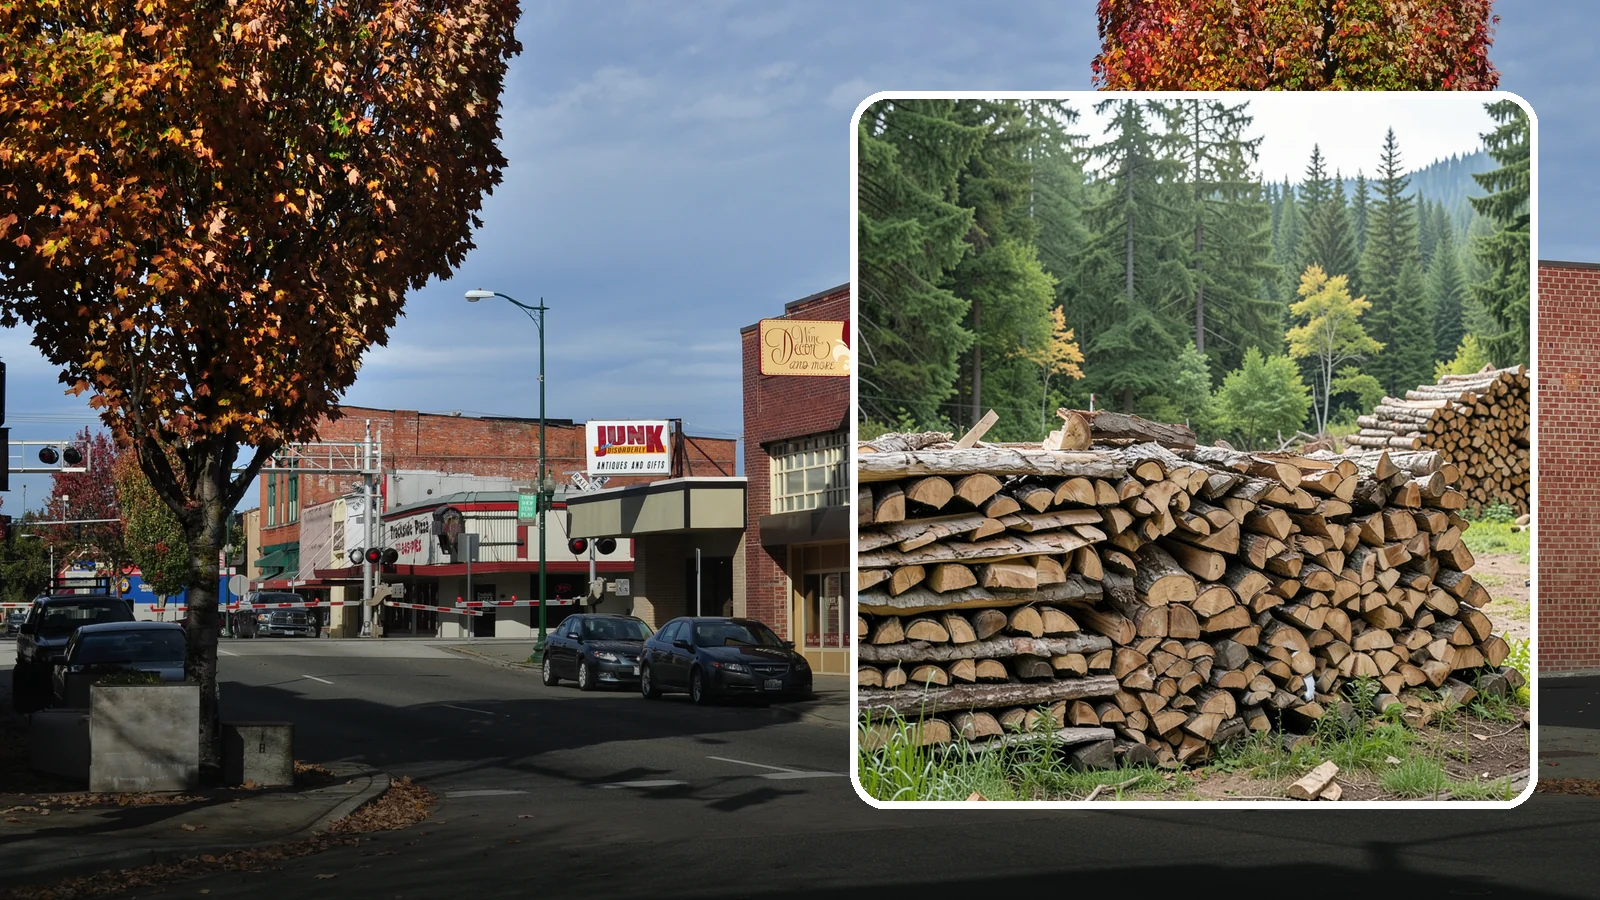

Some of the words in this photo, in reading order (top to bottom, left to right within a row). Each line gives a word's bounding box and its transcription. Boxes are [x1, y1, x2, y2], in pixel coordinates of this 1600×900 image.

[596, 425, 665, 457] JUNK
[607, 446, 646, 454] DISORDERLY
[596, 461, 628, 470] ANTIQUES
[631, 461, 644, 470] AND
[646, 460, 665, 469] GIFTS
[414, 519, 429, 535] Pizza
